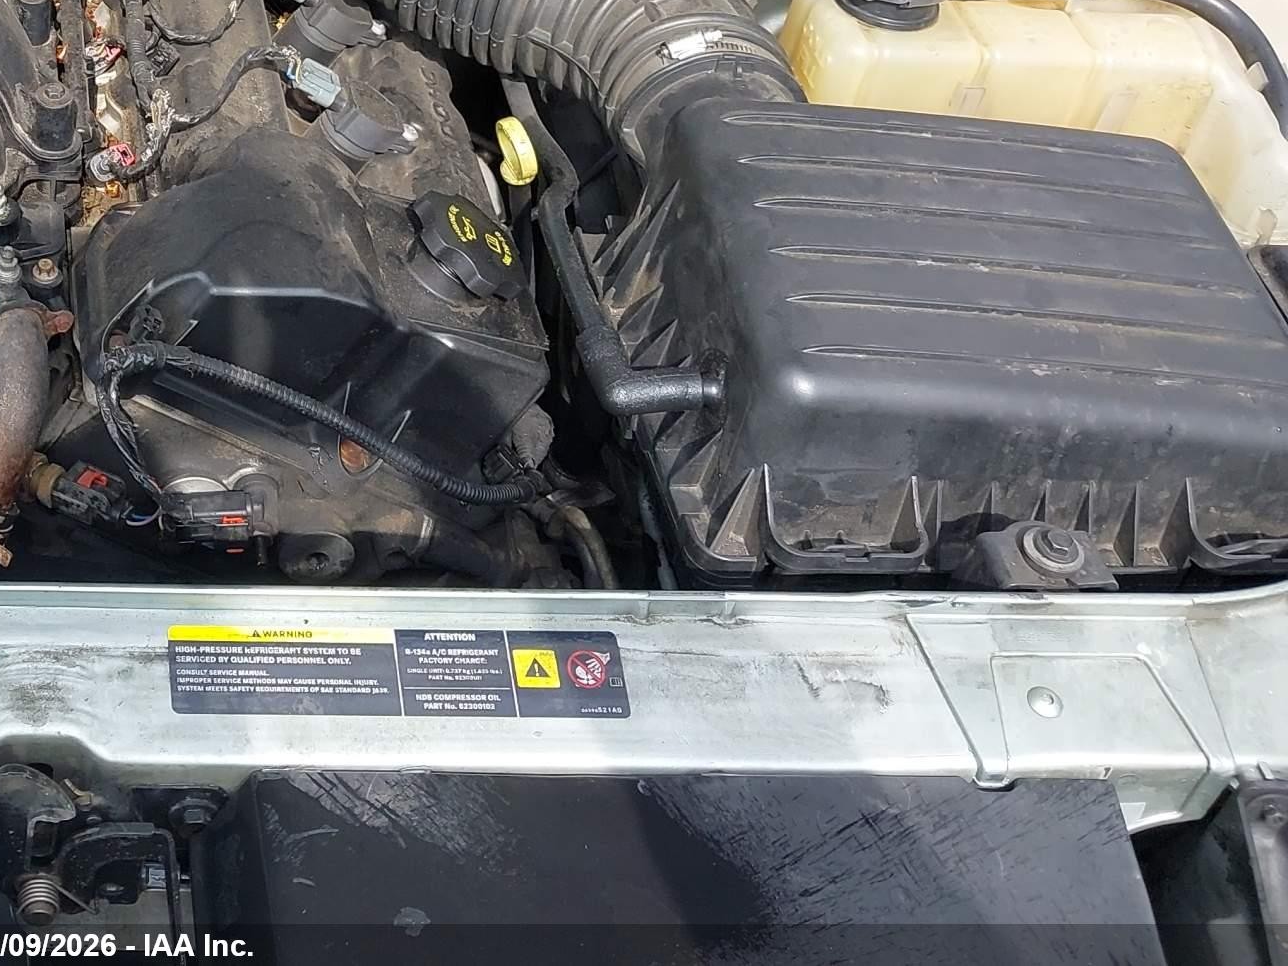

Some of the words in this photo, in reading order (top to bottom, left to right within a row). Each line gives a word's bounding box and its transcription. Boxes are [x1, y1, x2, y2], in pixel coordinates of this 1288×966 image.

[262, 630, 313, 638] WARNING
[424, 633, 476, 642] ATTENTION
[175, 646, 244, 654] HIGH-PRESSURE
[350, 648, 362, 656] BE
[230, 656, 275, 664] QUALIFIED
[424, 702, 443, 710] PART
